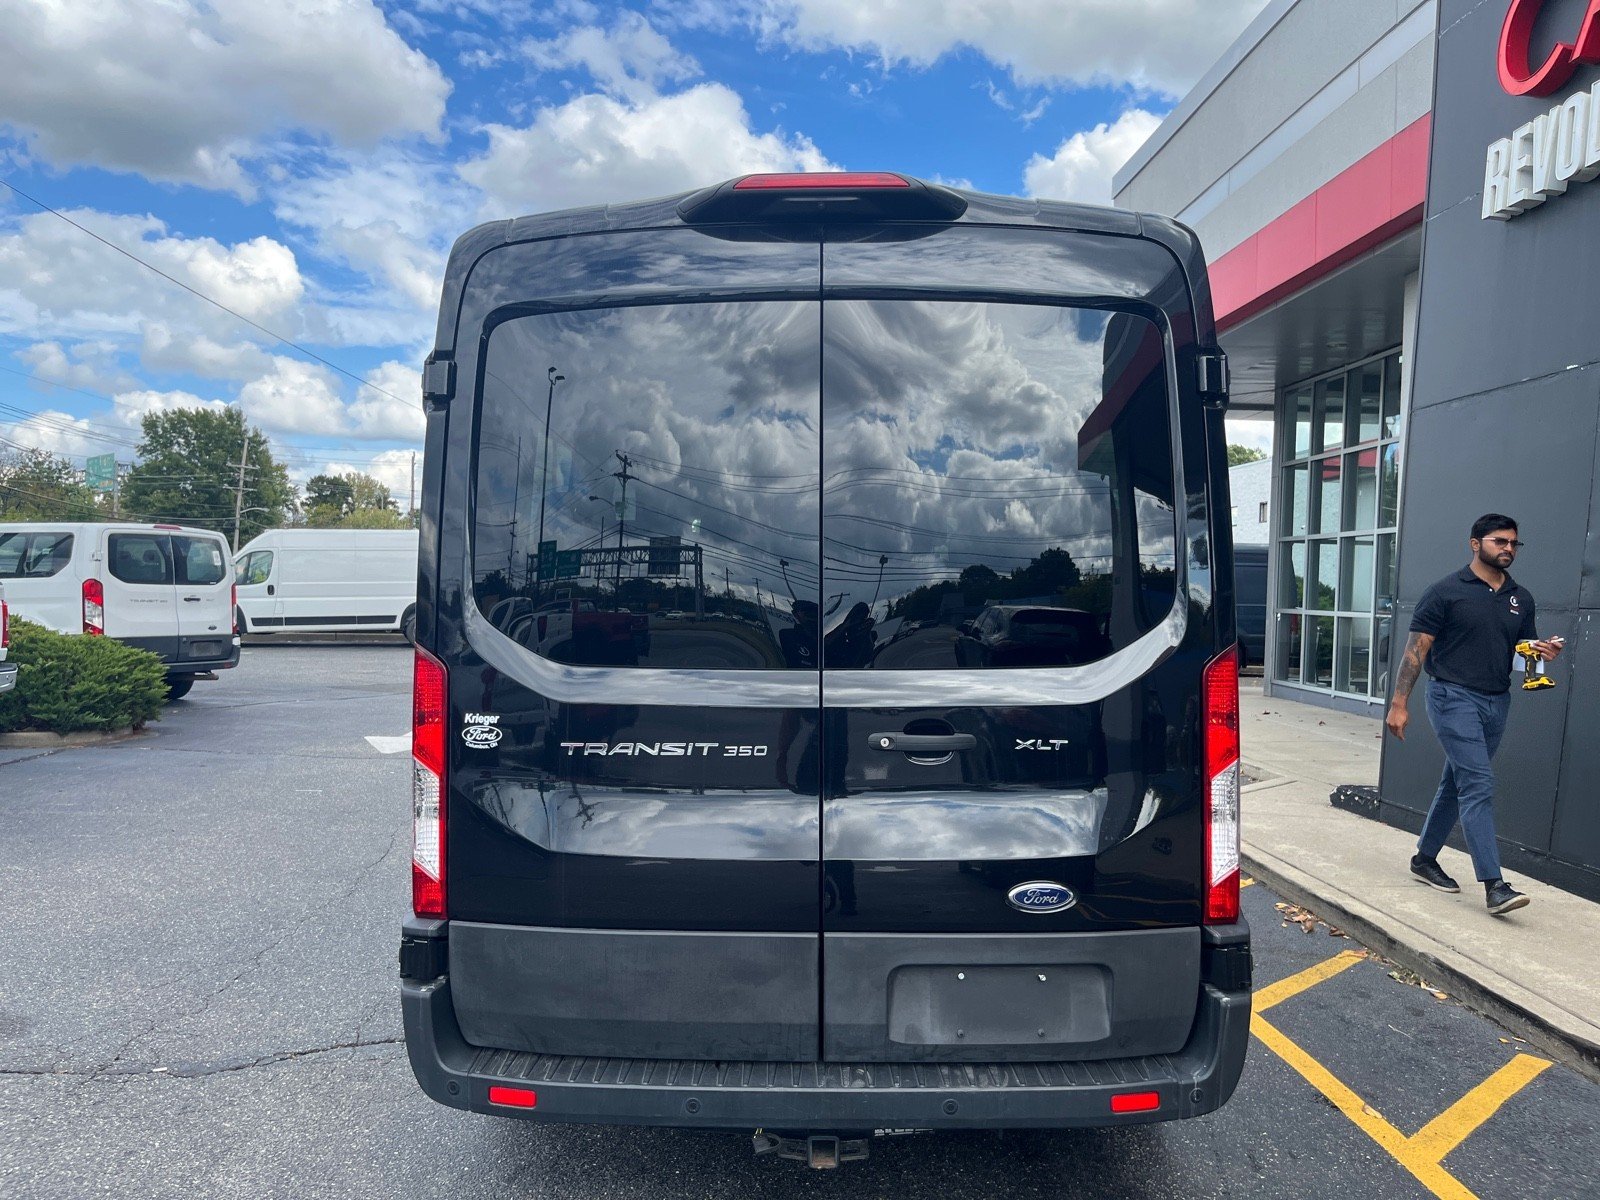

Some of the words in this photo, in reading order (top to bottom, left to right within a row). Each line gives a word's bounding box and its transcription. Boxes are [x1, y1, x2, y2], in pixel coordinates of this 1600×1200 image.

[464, 713, 500, 726] Krieger
[466, 726, 498, 741] Ford
[560, 742, 719, 756] TRANSIT
[723, 745, 768, 757] 350
[1014, 739, 1069, 751] XLT
[1023, 888, 1060, 904] Ford
